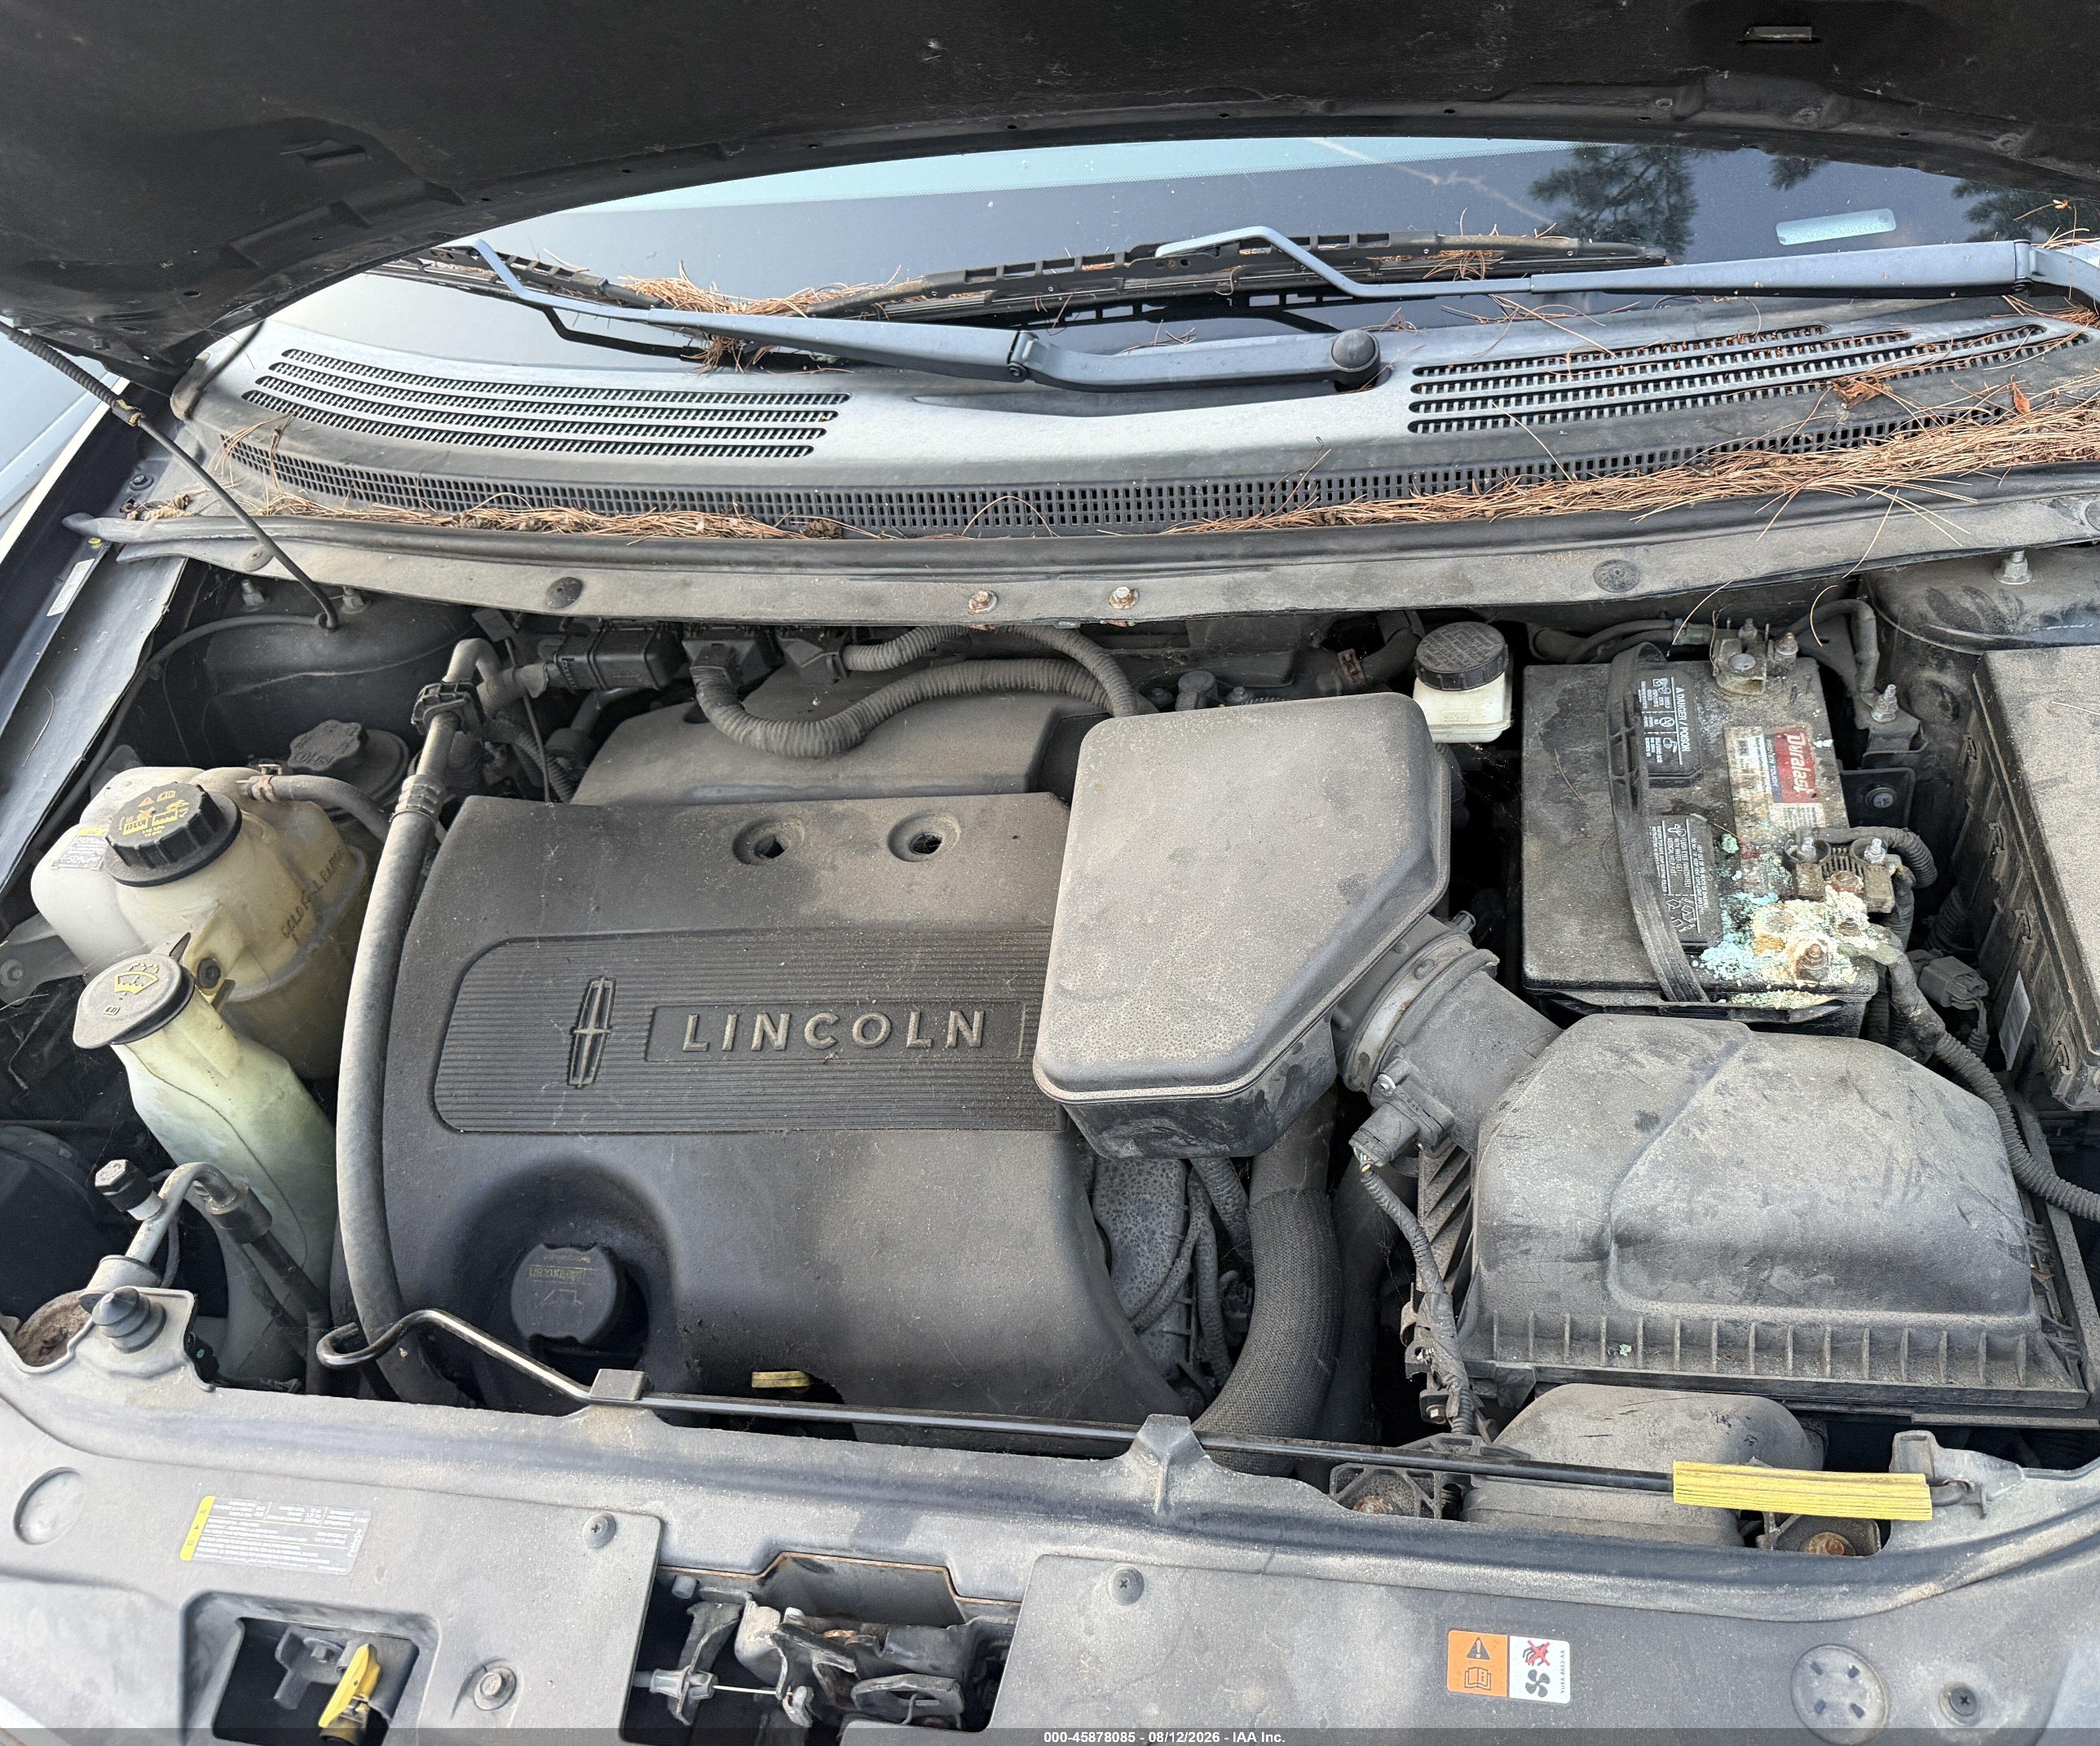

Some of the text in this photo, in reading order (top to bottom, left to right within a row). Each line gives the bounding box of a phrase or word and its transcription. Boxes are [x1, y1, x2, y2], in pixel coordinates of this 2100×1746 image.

[1676, 694, 1687, 720] DANGER
[1679, 727, 1691, 752] POISON
[1766, 739, 1779, 786] PROVEN TOUGH
[1785, 733, 1814, 793] Duralast
[682, 1010, 986, 1052] LINCOLN
